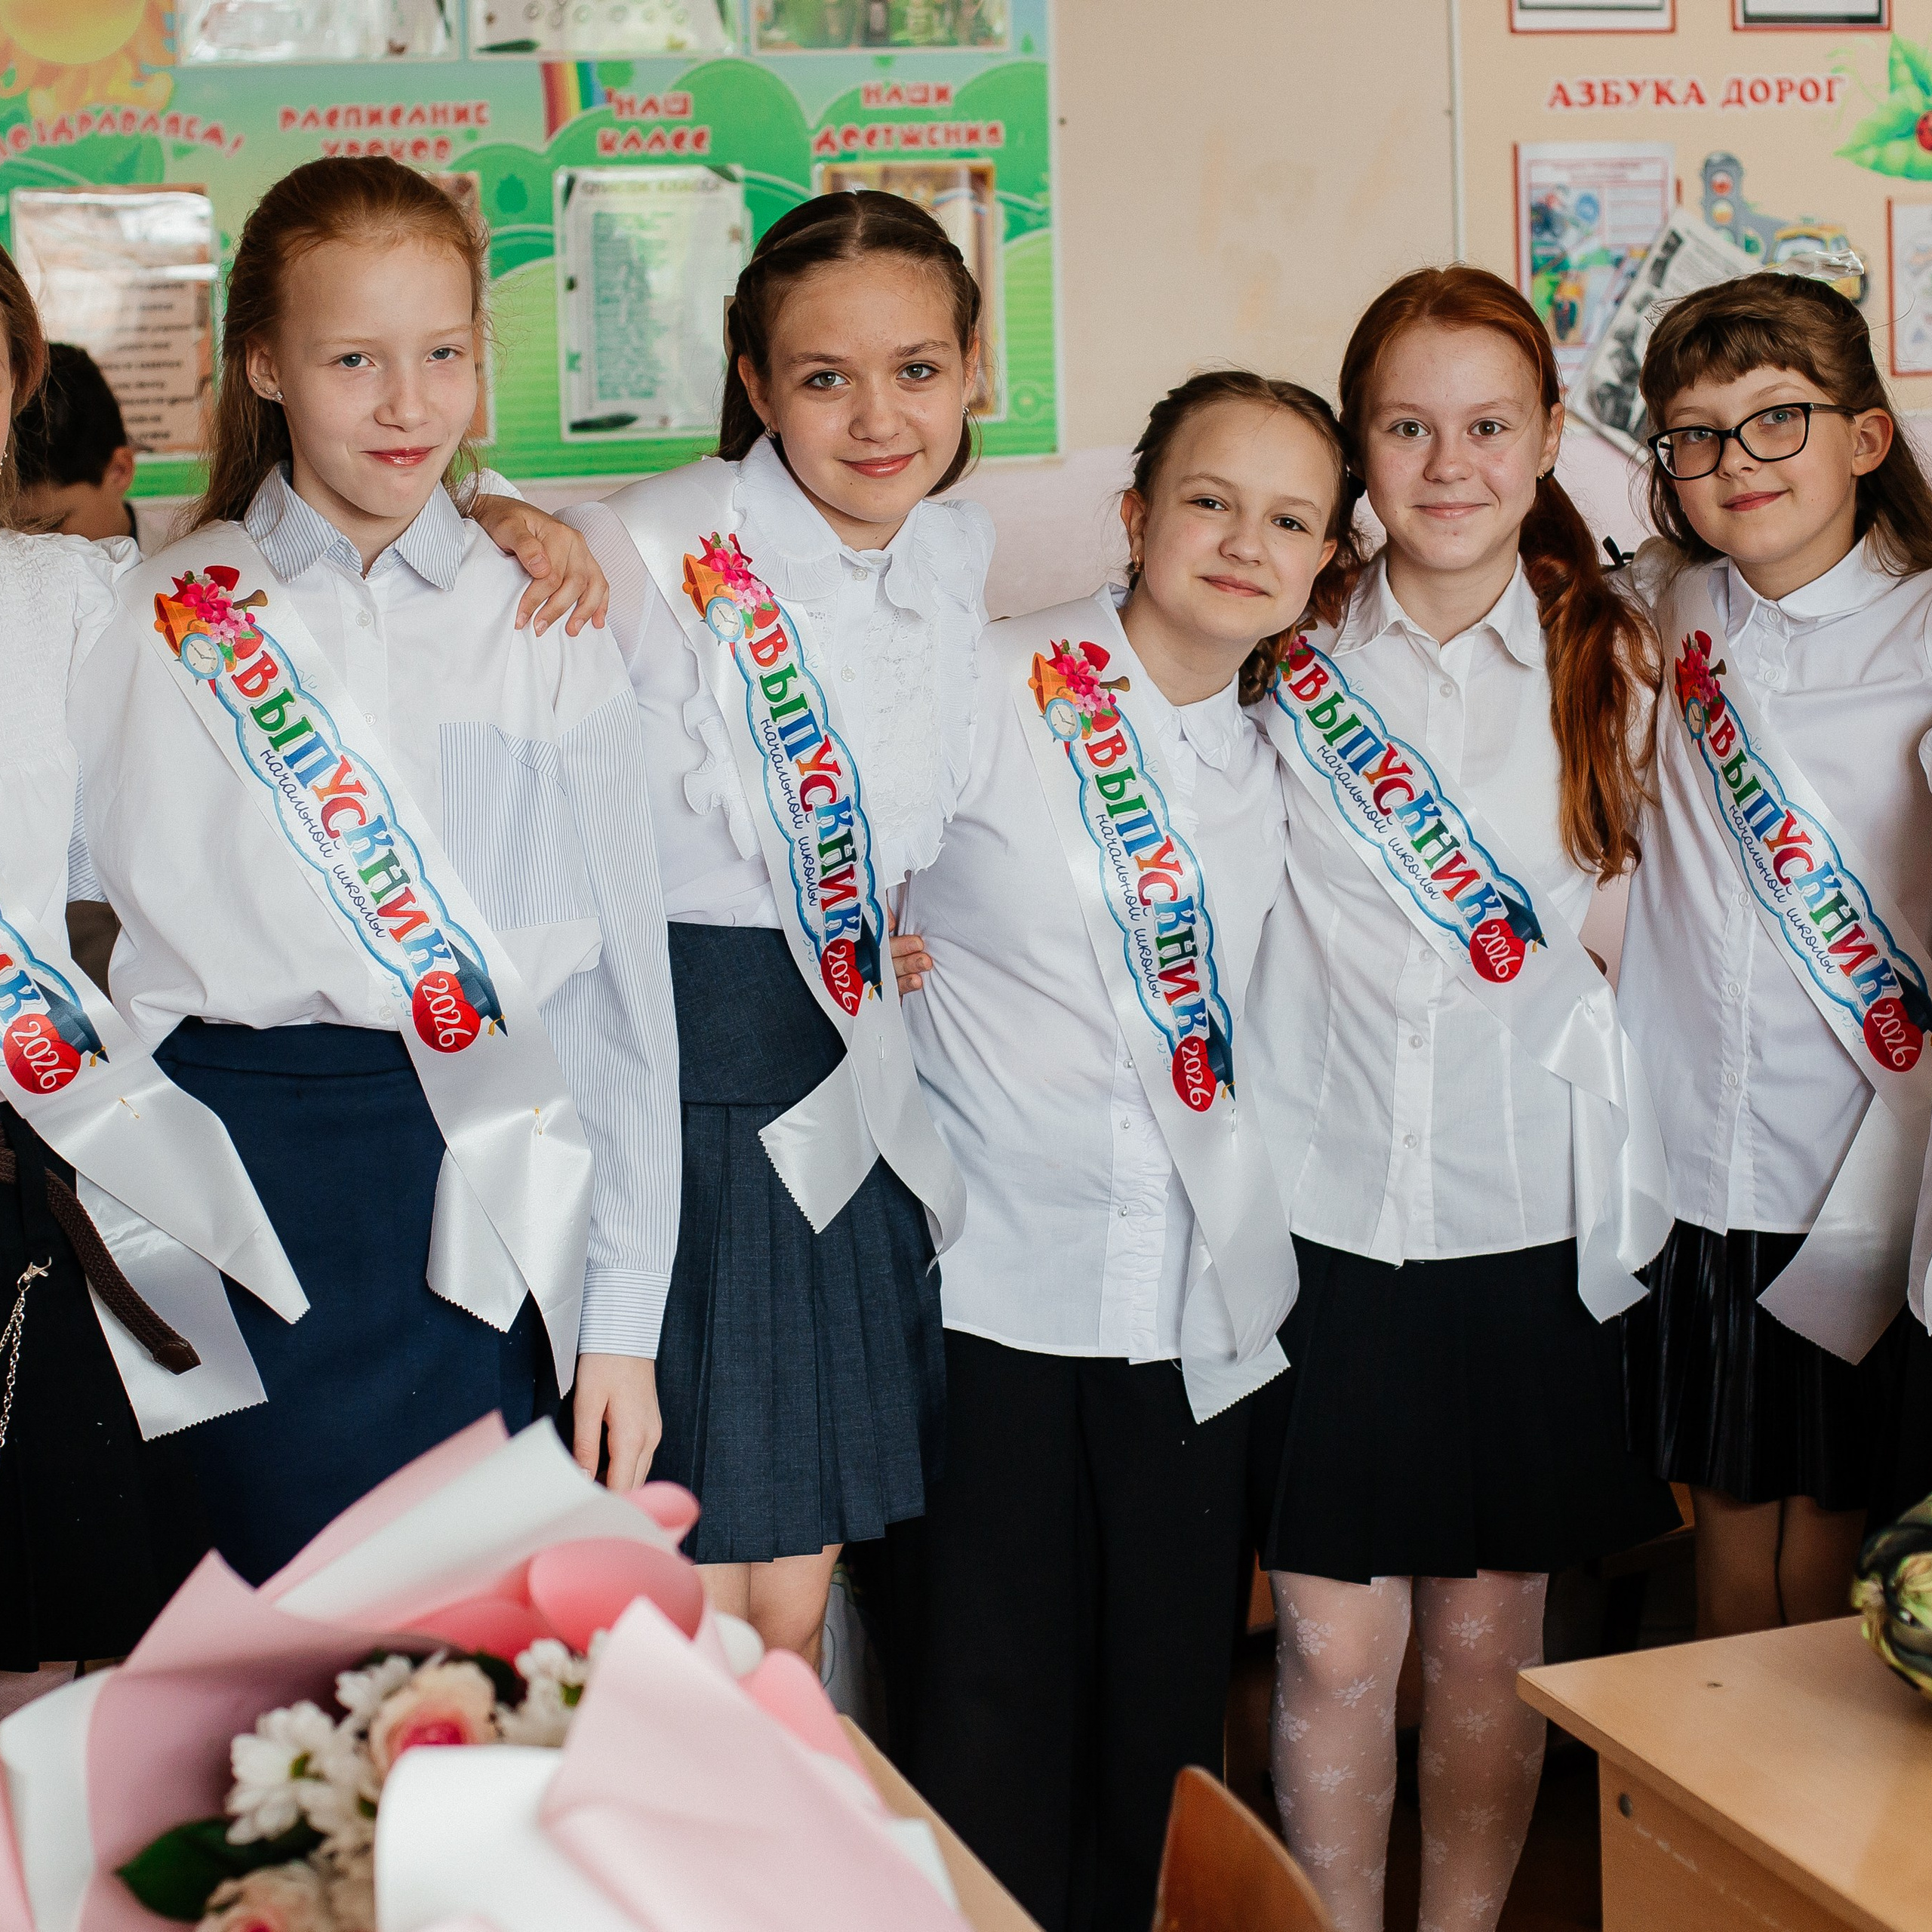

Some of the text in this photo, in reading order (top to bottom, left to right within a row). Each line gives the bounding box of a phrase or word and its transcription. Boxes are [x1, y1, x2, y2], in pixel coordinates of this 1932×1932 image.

[278, 101, 489, 131] РАСПИСАНИЕ
[614, 93, 692, 118] НАШ
[862, 83, 952, 106] НАШИ
[1547, 77, 1843, 108] АЗБУКА ДОРОГ
[0, 110, 245, 158] ОЗДРАВЛЯЕМ!
[598, 127, 711, 156] КЛАСС
[232, 649, 454, 977] ВЫПУСКНИК
[749, 624, 863, 944] ВЫПУСКНИК
[760, 717, 818, 907] начальной школы
[1287, 663, 1504, 929] ВЫПУСКНИК
[260, 749, 386, 938] начальной школы
[1317, 744, 1441, 901] начальной школы
[1084, 728, 1208, 1039] ВЫПУСКНИК
[1709, 714, 1899, 1007] ВЫПУСКНИК
[1729, 804, 1837, 975] начальной школы
[1096, 813, 1161, 999] начальной школы
[826, 945, 859, 1011] 2026
[1476, 924, 1521, 978] 2026
[421, 977, 472, 1048] 2026
[1871, 1004, 1918, 1066] 2026
[11, 1020, 74, 1090] 2026
[1181, 1042, 1211, 1106] 2026
